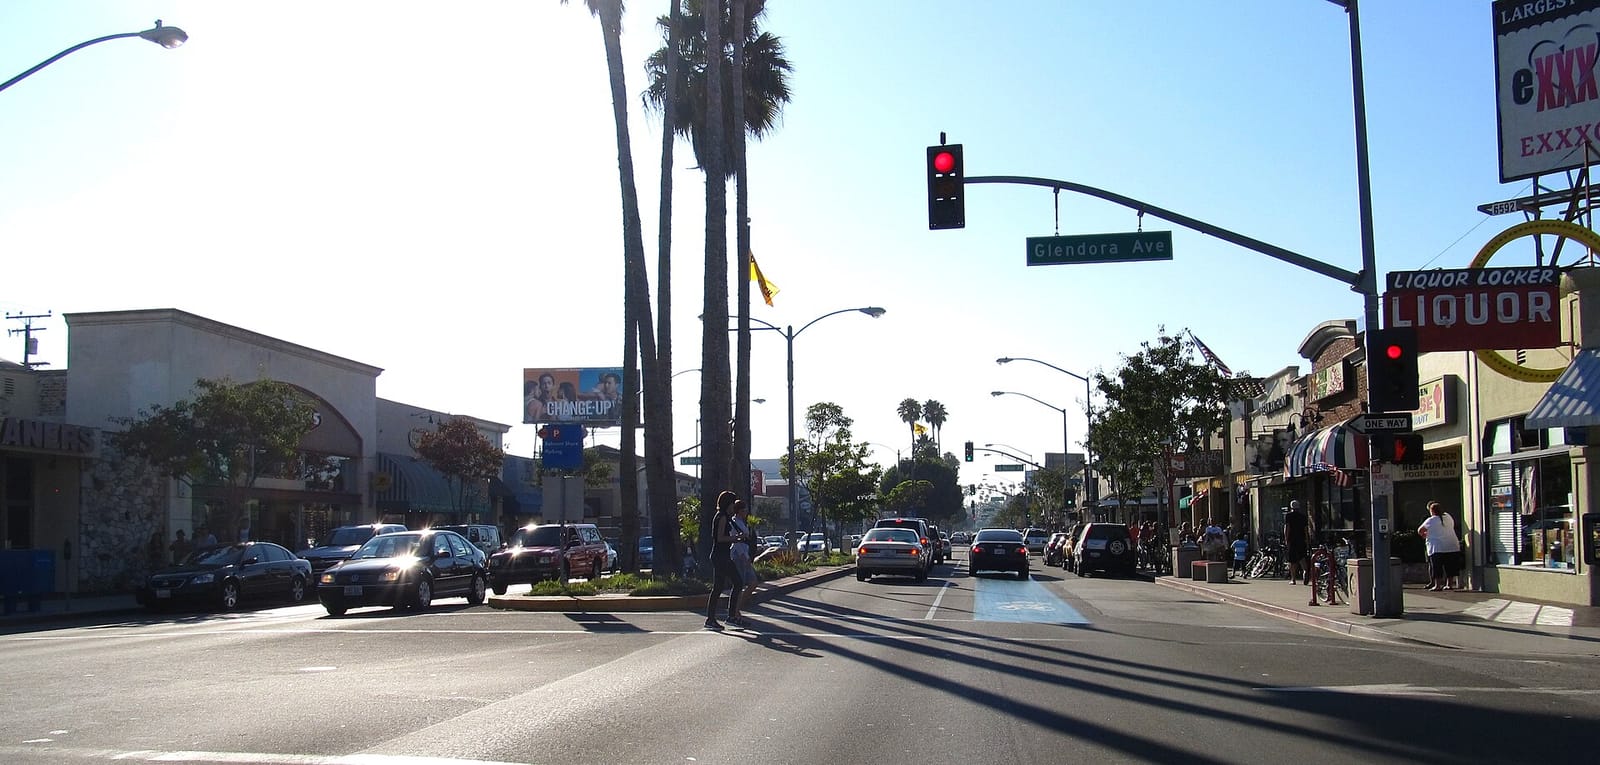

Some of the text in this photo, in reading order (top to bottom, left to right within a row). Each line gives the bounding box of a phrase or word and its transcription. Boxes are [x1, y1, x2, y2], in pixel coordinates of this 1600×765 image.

[1493, 203, 1516, 214] 6592
[1034, 239, 1165, 258] Glendora Ave
[1394, 268, 1554, 290] LIQUOR LOCKER
[1392, 291, 1553, 328] LIQUOR
[547, 400, 612, 416] CHANGE-UP
[1365, 419, 1384, 428] ONE
[1386, 419, 1405, 428] WAY
[553, 429, 560, 438] P
[1403, 462, 1457, 471] RESTAURANT
